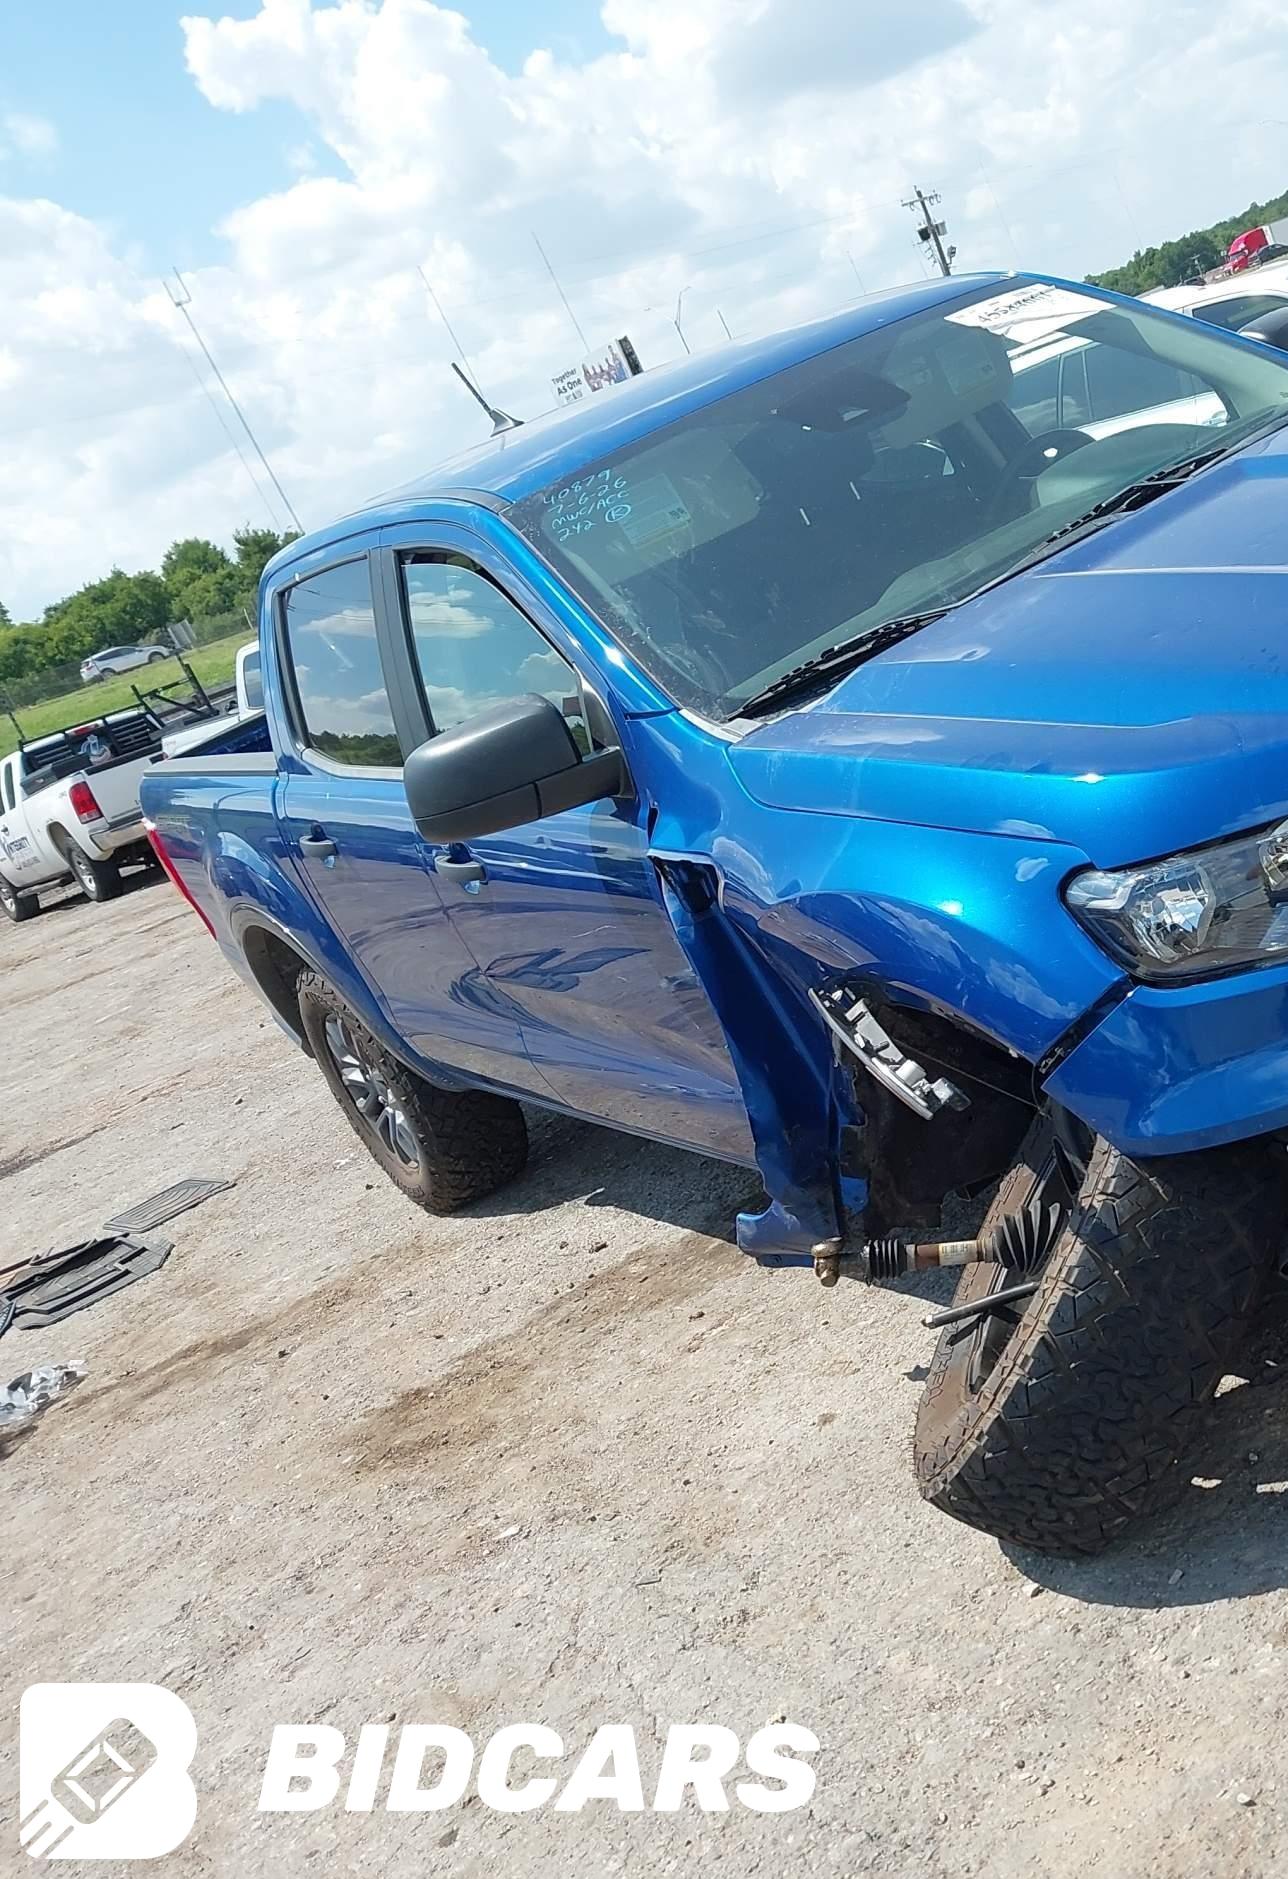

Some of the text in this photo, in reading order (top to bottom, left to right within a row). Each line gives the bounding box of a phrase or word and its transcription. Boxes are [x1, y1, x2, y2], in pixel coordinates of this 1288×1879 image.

[552, 368, 577, 385] Together
[567, 378, 583, 391] One
[543, 469, 611, 505] 40879
